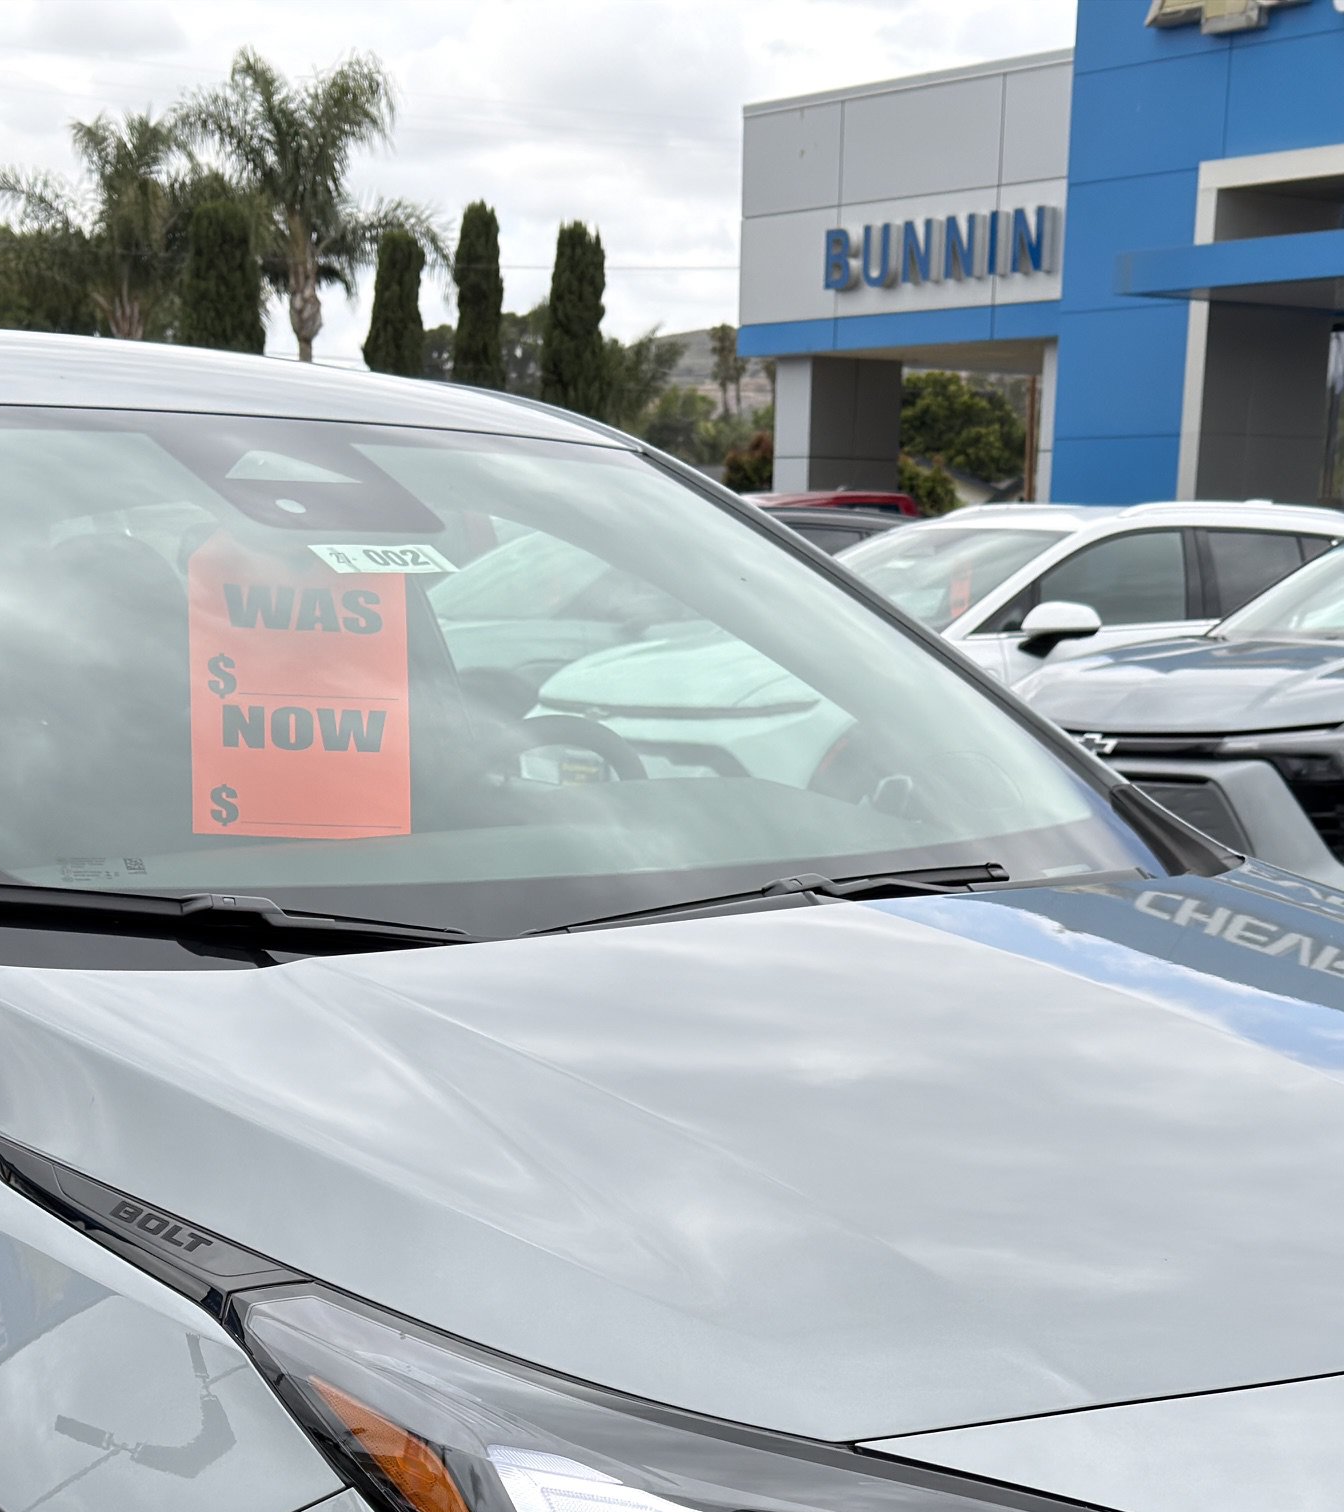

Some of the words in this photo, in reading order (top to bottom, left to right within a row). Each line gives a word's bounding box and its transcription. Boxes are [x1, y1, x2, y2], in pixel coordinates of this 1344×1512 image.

[824, 206, 1048, 290] BUNNIN
[362, 549, 430, 566] 002
[223, 583, 383, 635] WAS
[208, 652, 237, 699] $
[222, 704, 387, 753] NOW
[210, 783, 239, 827] $
[109, 1200, 213, 1252] BOLT
